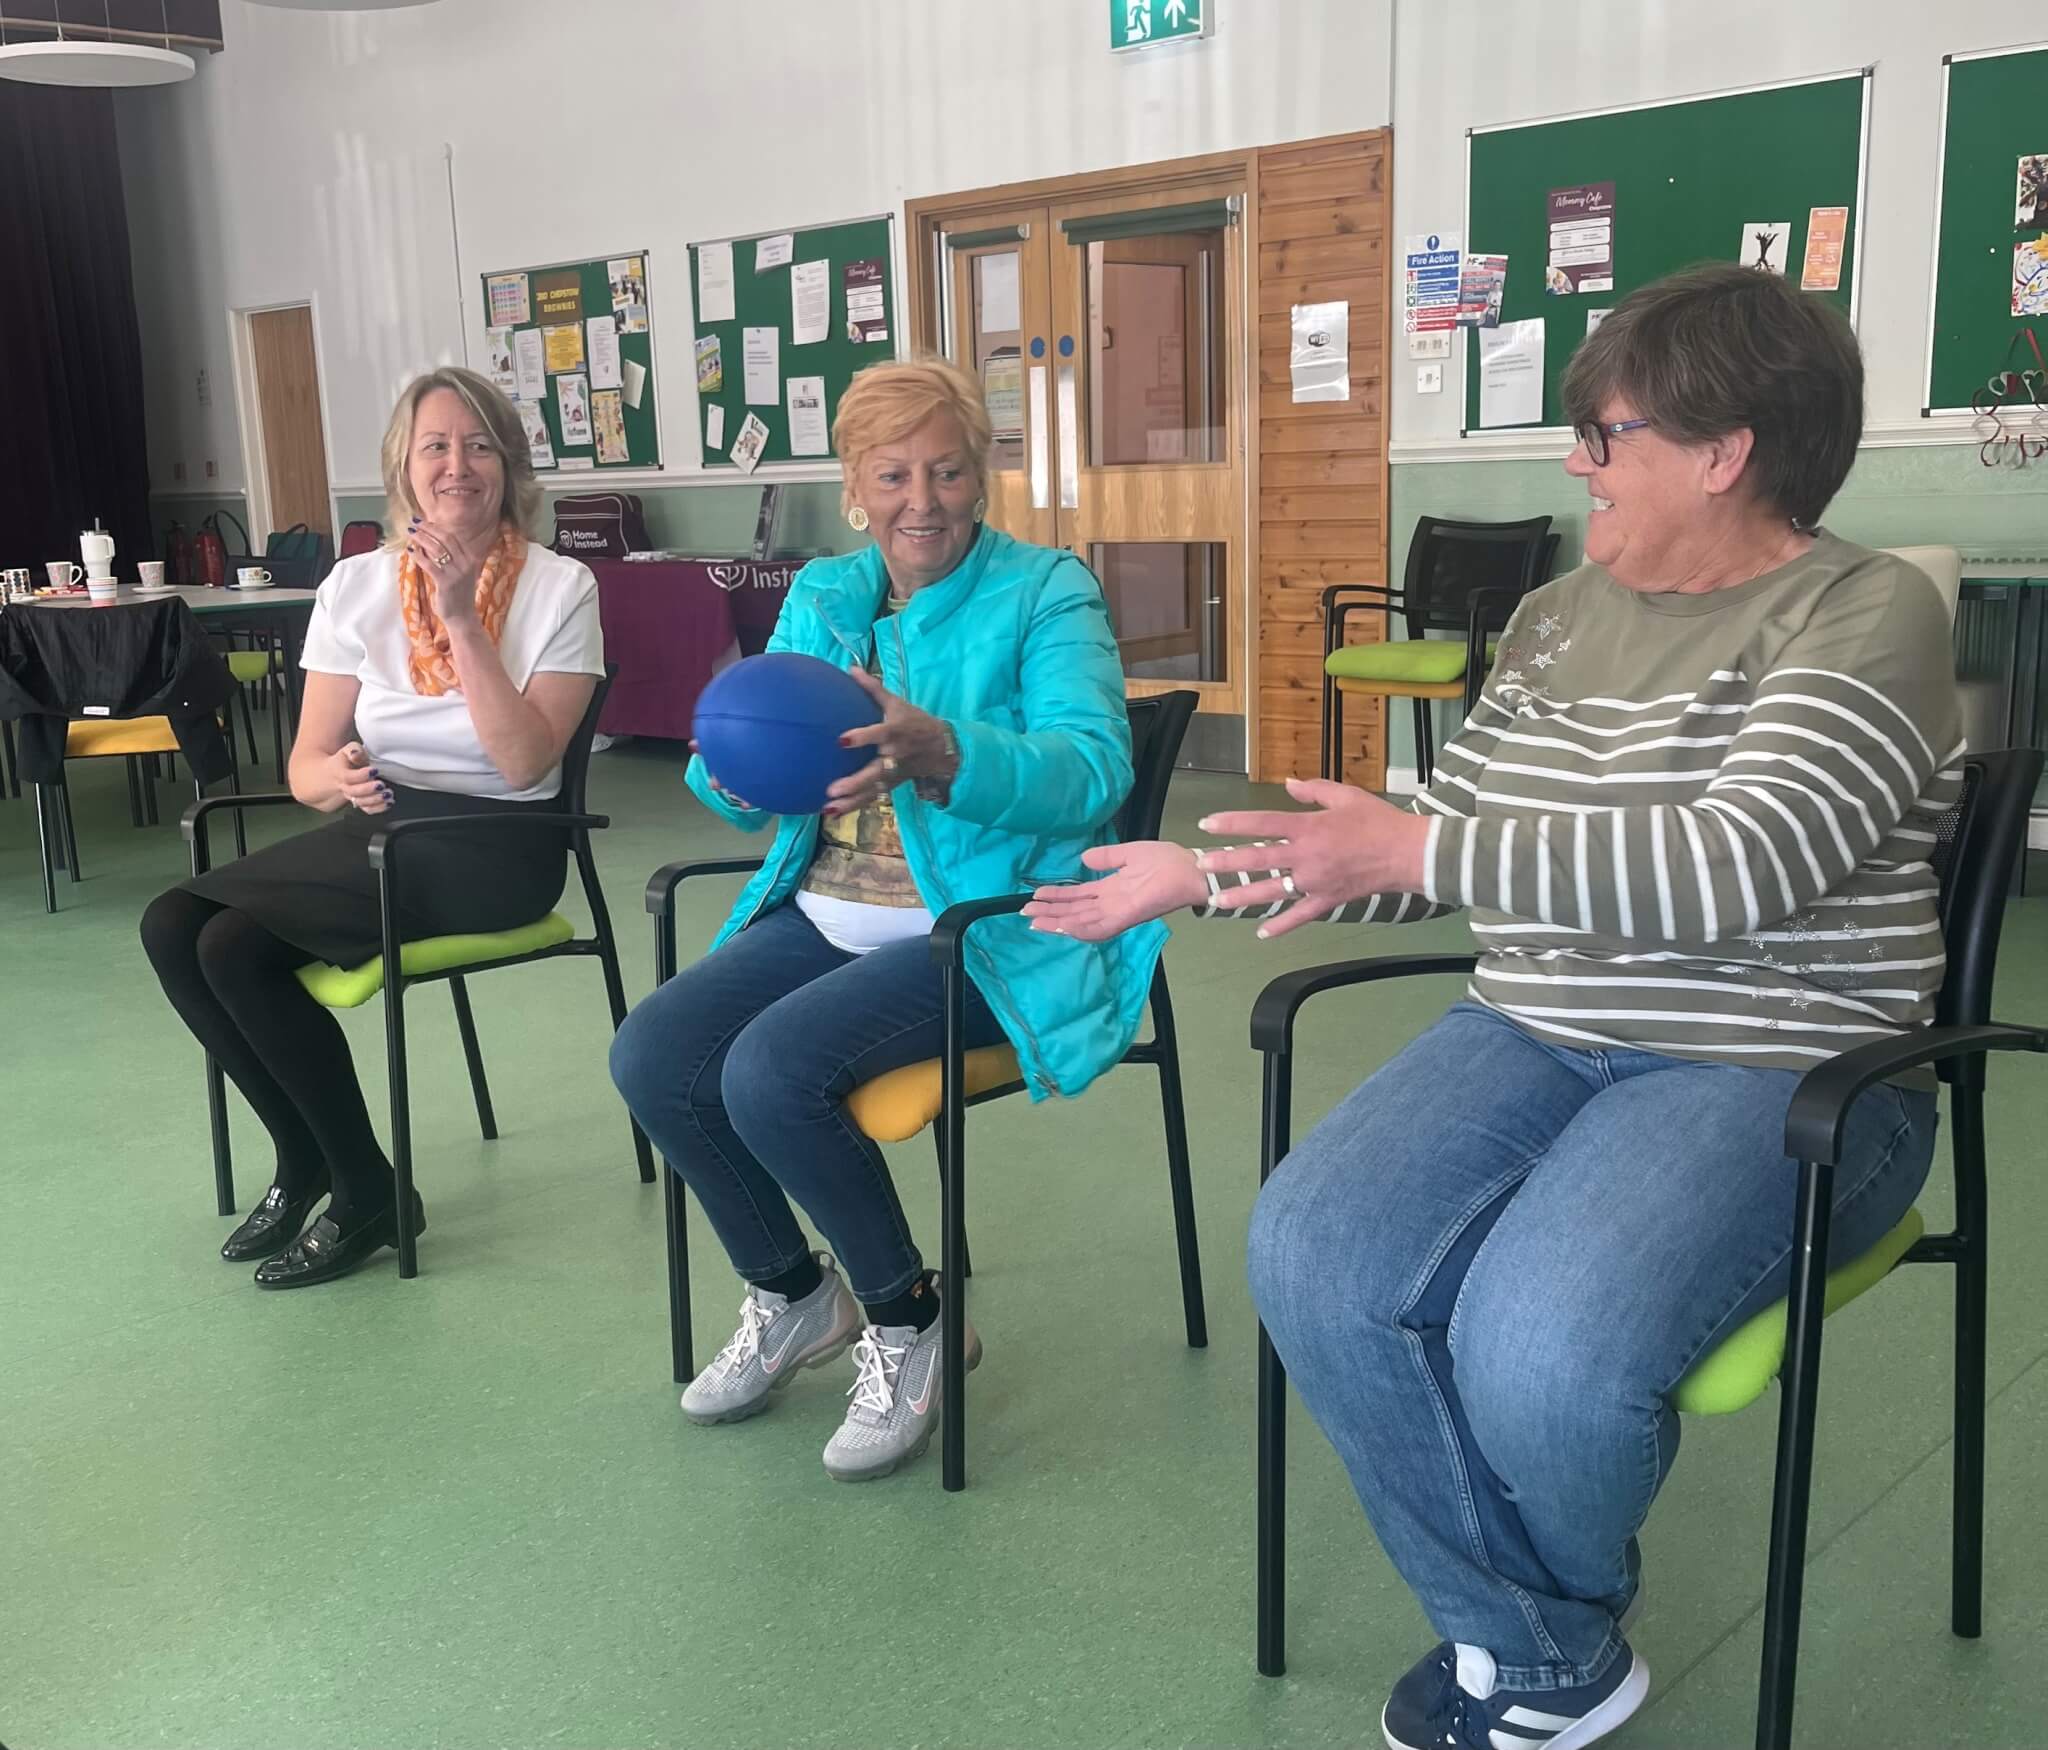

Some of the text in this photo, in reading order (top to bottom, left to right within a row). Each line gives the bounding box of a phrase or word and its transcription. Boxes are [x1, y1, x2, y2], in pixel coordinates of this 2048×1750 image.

[1411, 253, 1455, 265] Fire Action
[543, 300, 576, 313] BROWNIES
[572, 530, 599, 540] Home
[574, 538, 608, 549] Instead
